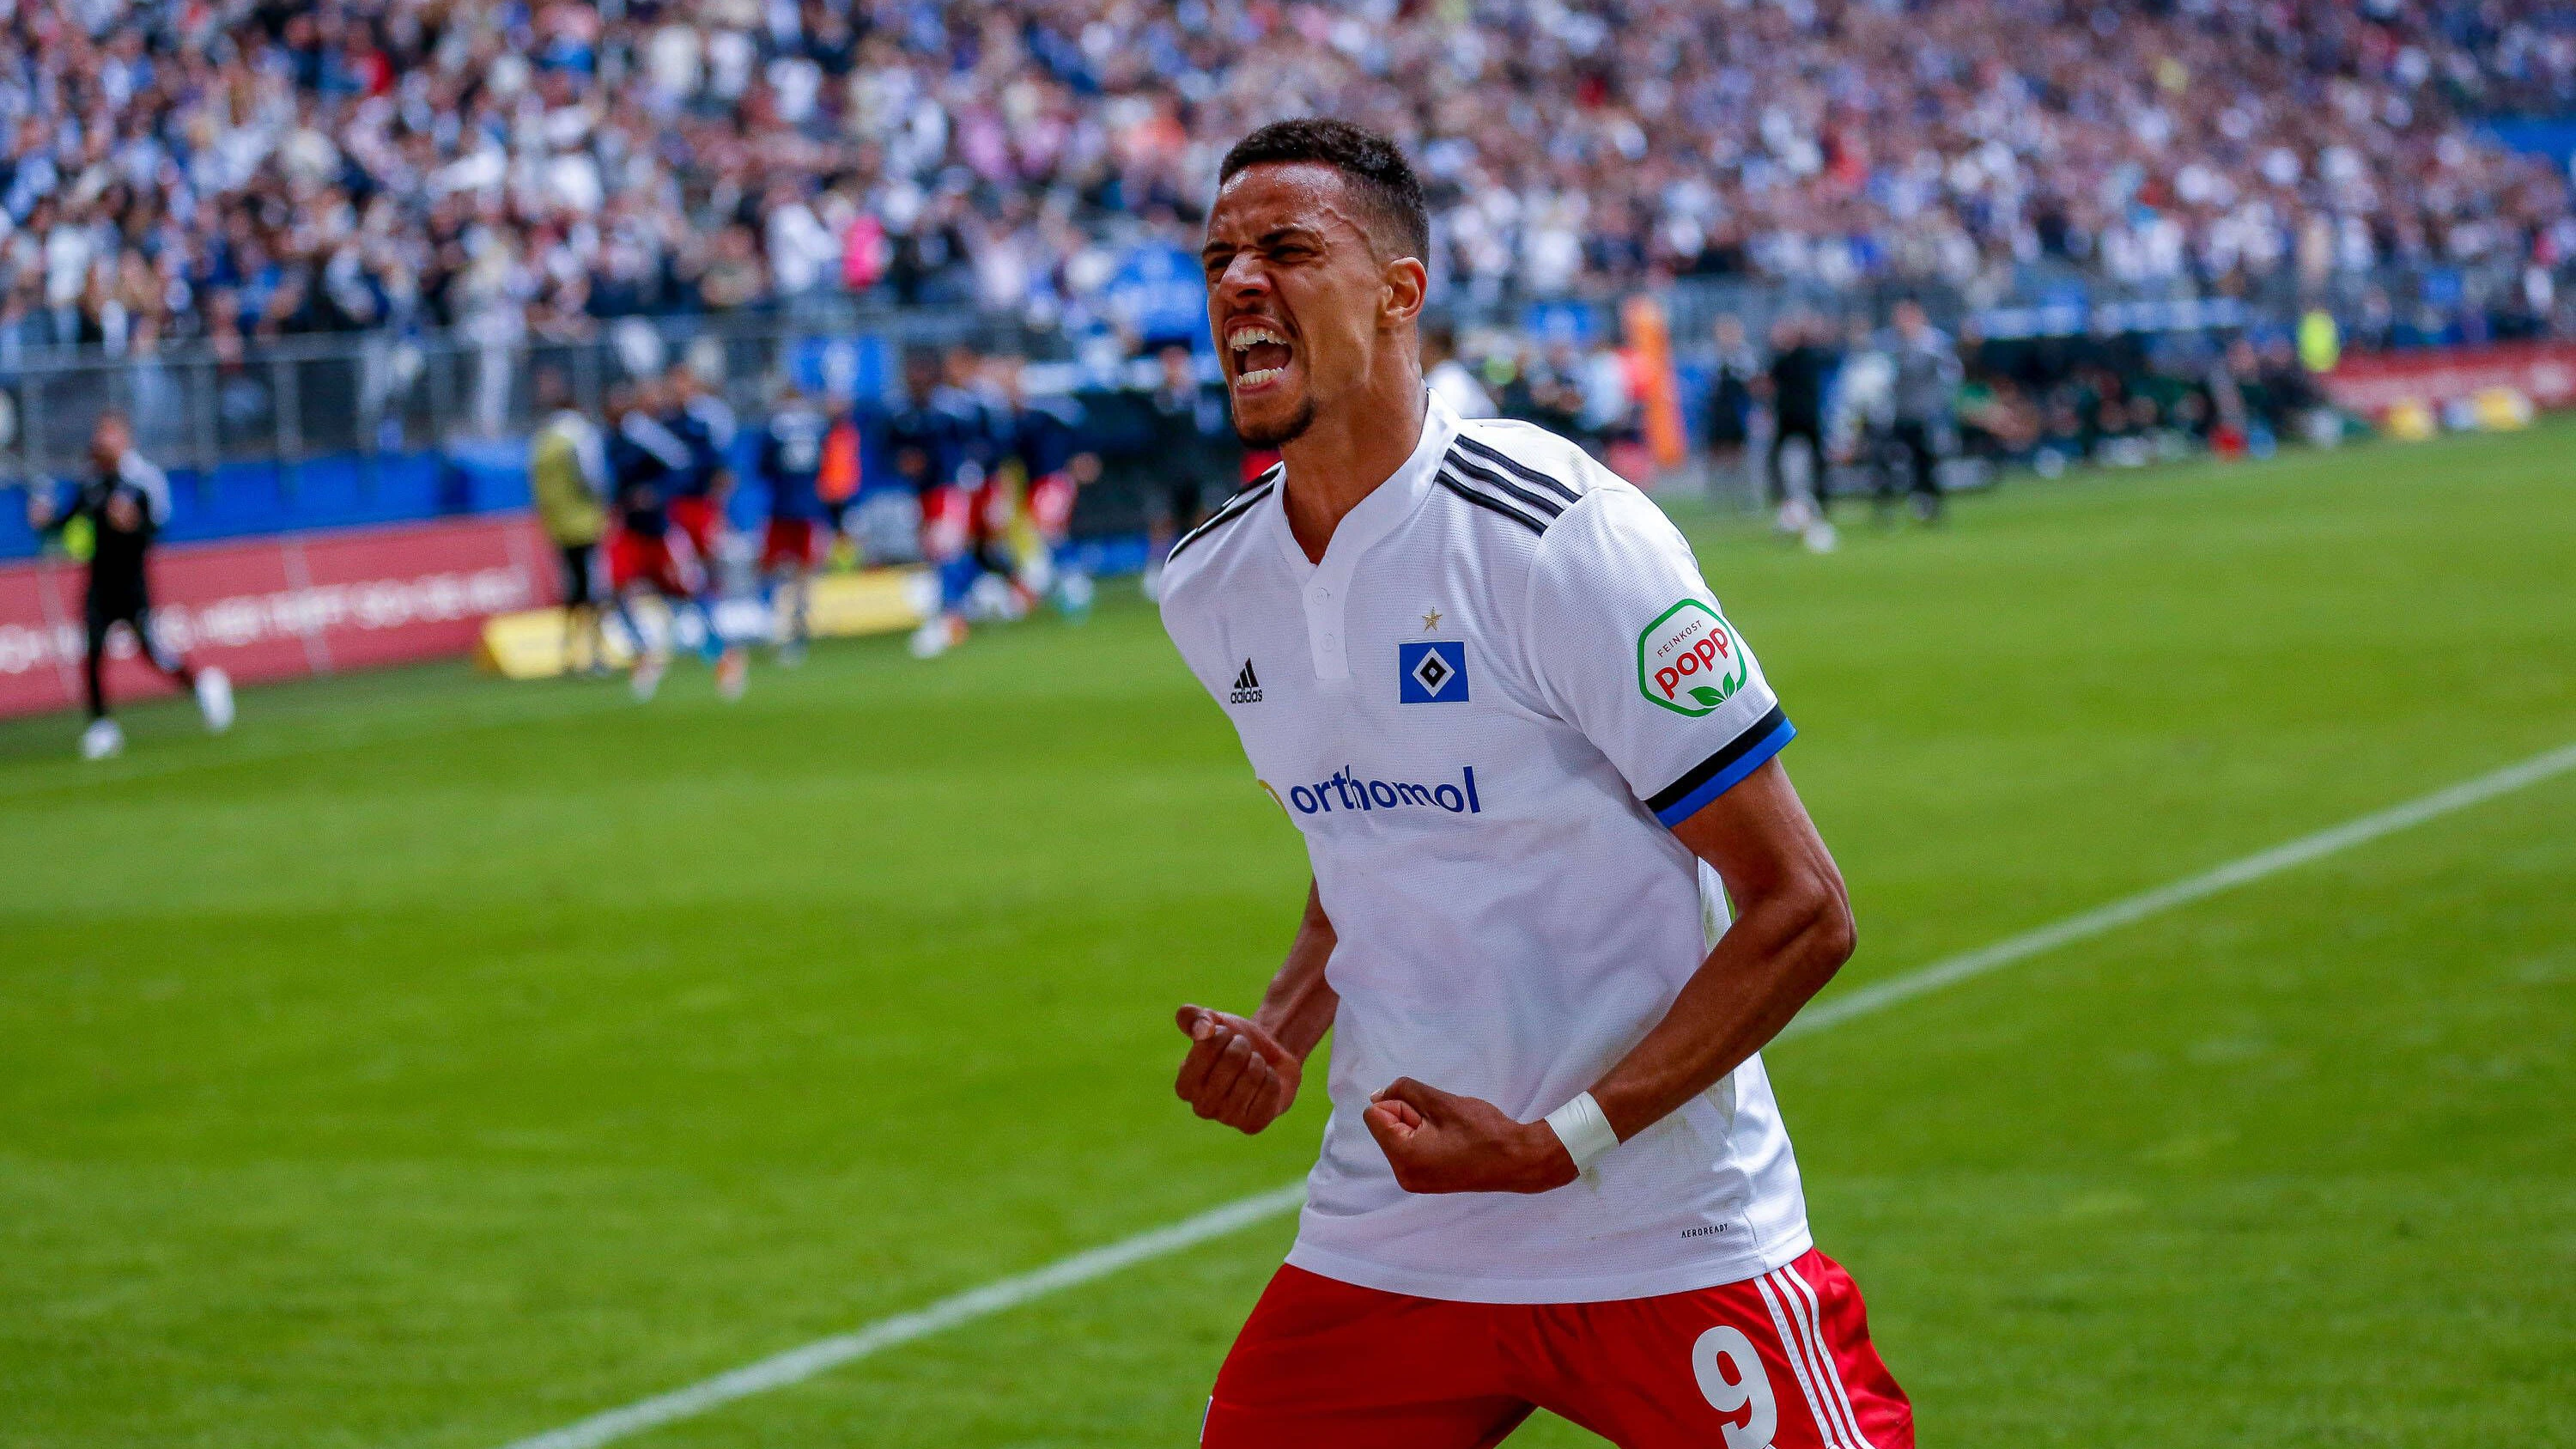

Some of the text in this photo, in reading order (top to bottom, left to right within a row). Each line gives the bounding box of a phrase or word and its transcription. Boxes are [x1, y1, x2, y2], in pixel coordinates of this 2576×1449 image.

[1656, 619, 1703, 658] FEINKOST
[1654, 628, 1728, 700] popp
[1230, 688, 1263, 704] adidas
[1290, 764, 1481, 814] orthomol
[1681, 1222, 1728, 1239] AEROREADY
[1692, 1325, 1777, 1449] 9
